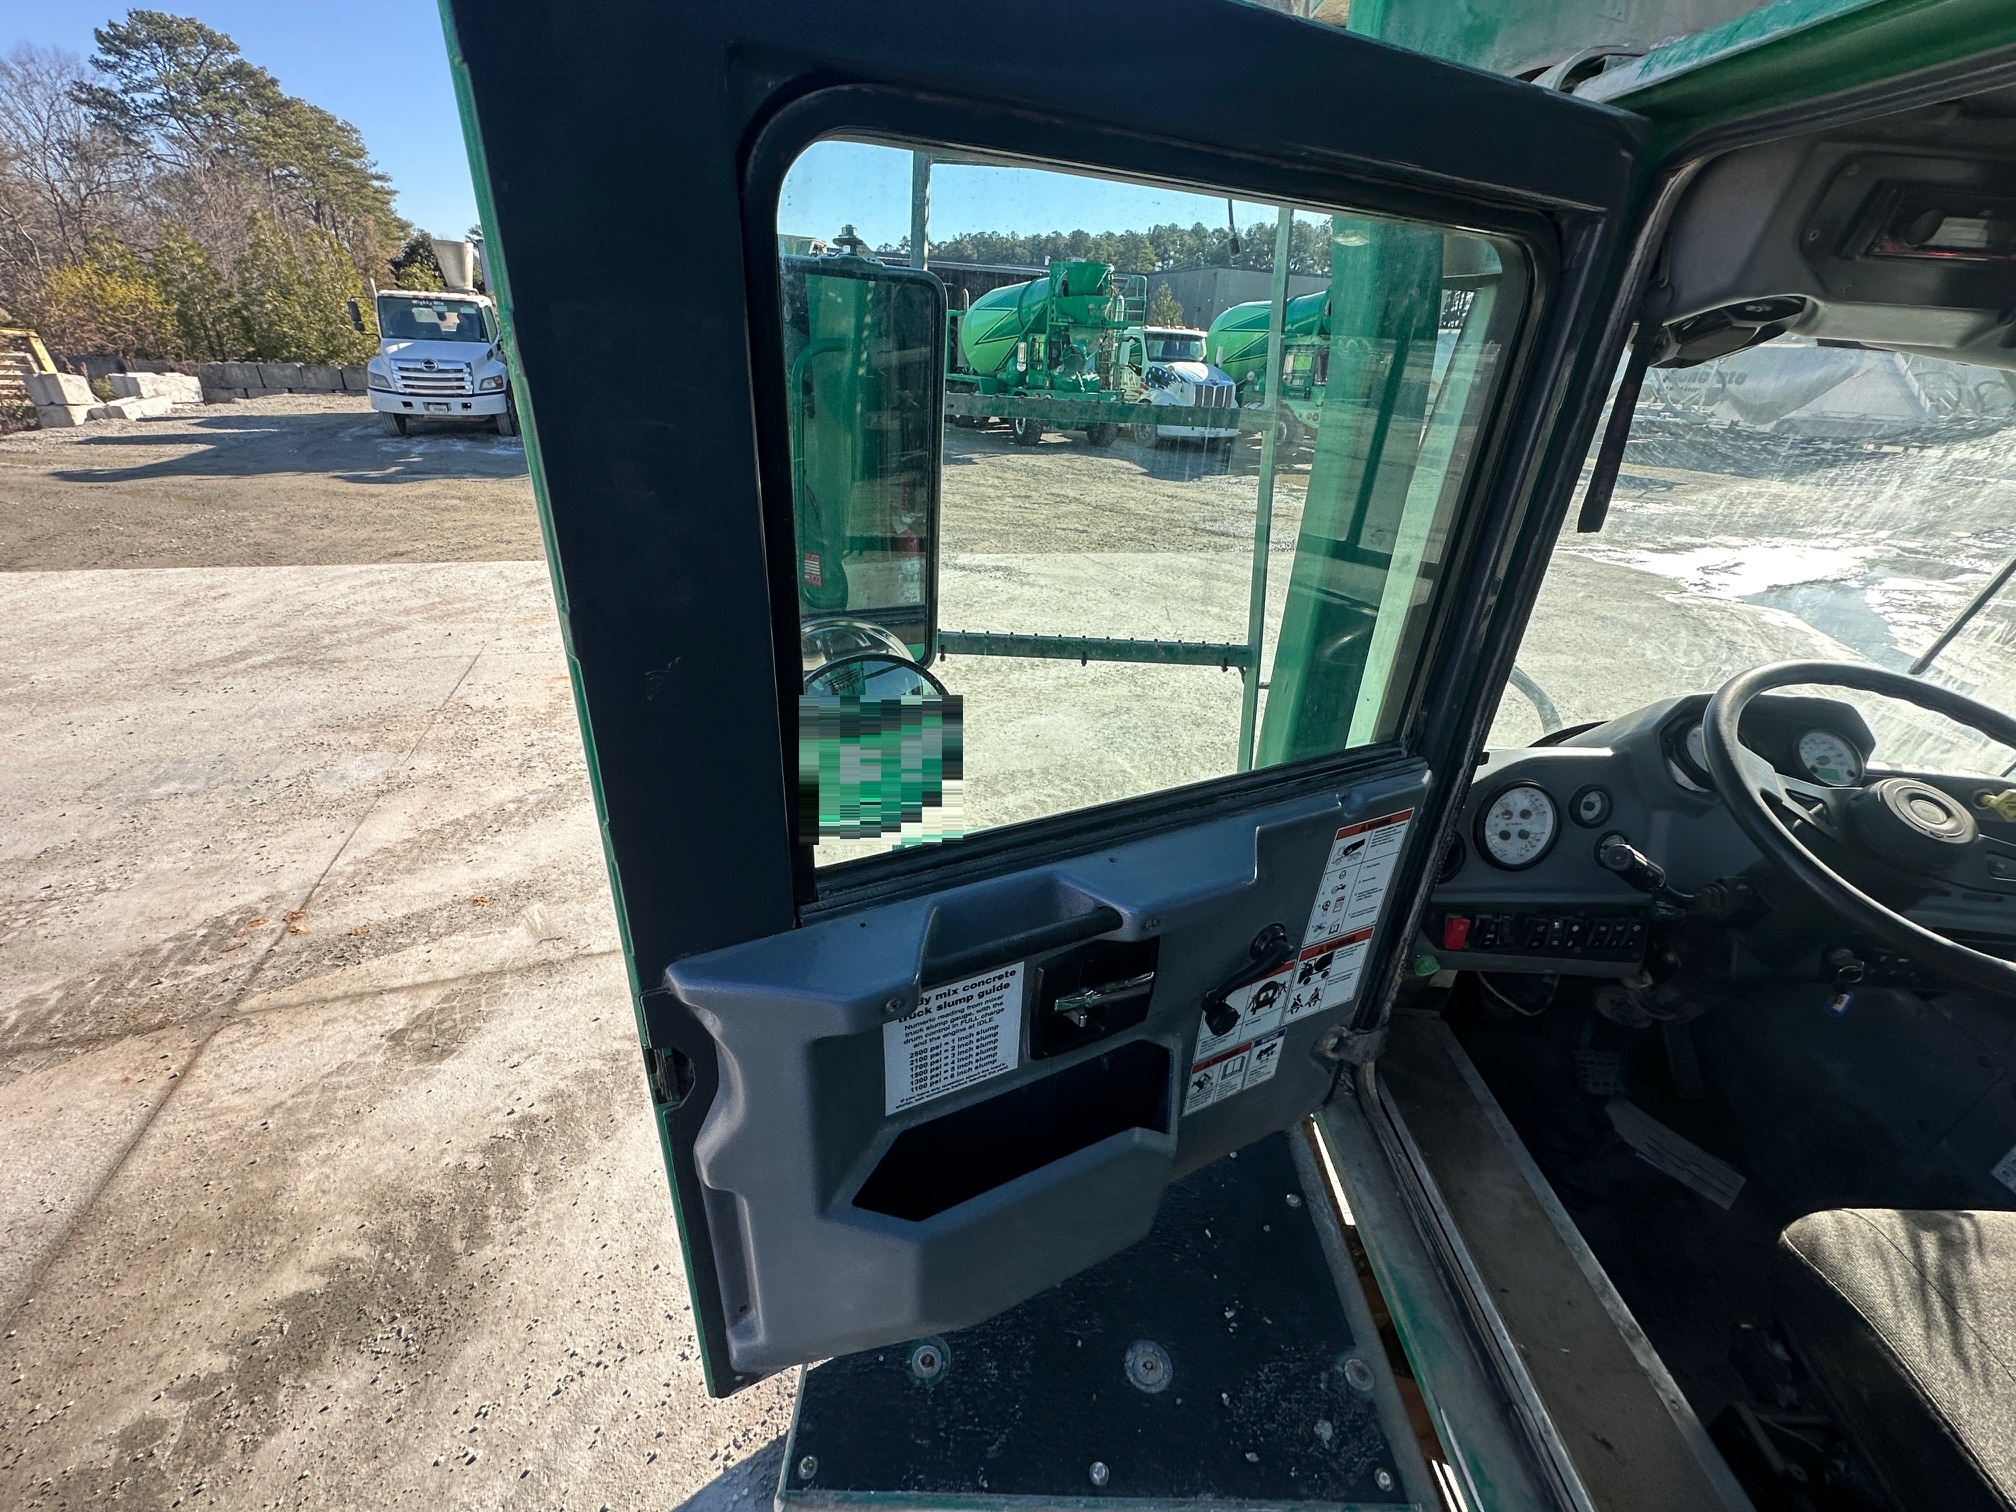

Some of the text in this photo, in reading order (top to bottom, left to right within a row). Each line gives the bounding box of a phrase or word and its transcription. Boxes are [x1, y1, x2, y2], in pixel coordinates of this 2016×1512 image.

[935, 970, 1016, 1000] mix concrete
[936, 995, 974, 1011] slump
[977, 982, 1010, 999] guide
[903, 1035, 923, 1045] drum
[924, 1024, 950, 1038] control
[960, 1016, 979, 1026] FULL
[981, 1008, 1005, 1019] charge
[905, 994, 1004, 1031] Numeric reading from mixer
[905, 1027, 924, 1037] truck
[926, 1020, 948, 1031] slump
[976, 1005, 991, 1014] with
[909, 1048, 928, 1059] 2500
[930, 1043, 942, 1053] psi
[958, 1032, 974, 1042] inch
[976, 1025, 999, 1036] slump
[909, 1055, 928, 1066] 2100
[930, 1050, 942, 1060] psi
[957, 1040, 974, 1049] inch
[976, 1031, 998, 1043] slump
[913, 1039, 927, 1048] and
[942, 1027, 967, 1038] engine
[910, 1062, 928, 1072] 1700
[930, 1057, 942, 1067] psi
[957, 1047, 974, 1056] inch
[975, 1039, 998, 1050] slump
[910, 1069, 928, 1079] 1500
[930, 1064, 942, 1074] psi
[957, 1054, 973, 1063] inch
[975, 1045, 998, 1057] slump
[910, 1076, 928, 1086] 1300
[930, 1070, 942, 1081] psi
[957, 1060, 973, 1070] inch
[975, 1052, 997, 1063] slump
[910, 1082, 928, 1093] 1100
[930, 1077, 942, 1087] psi
[957, 1067, 973, 1077] inch
[974, 1059, 997, 1070] slump
